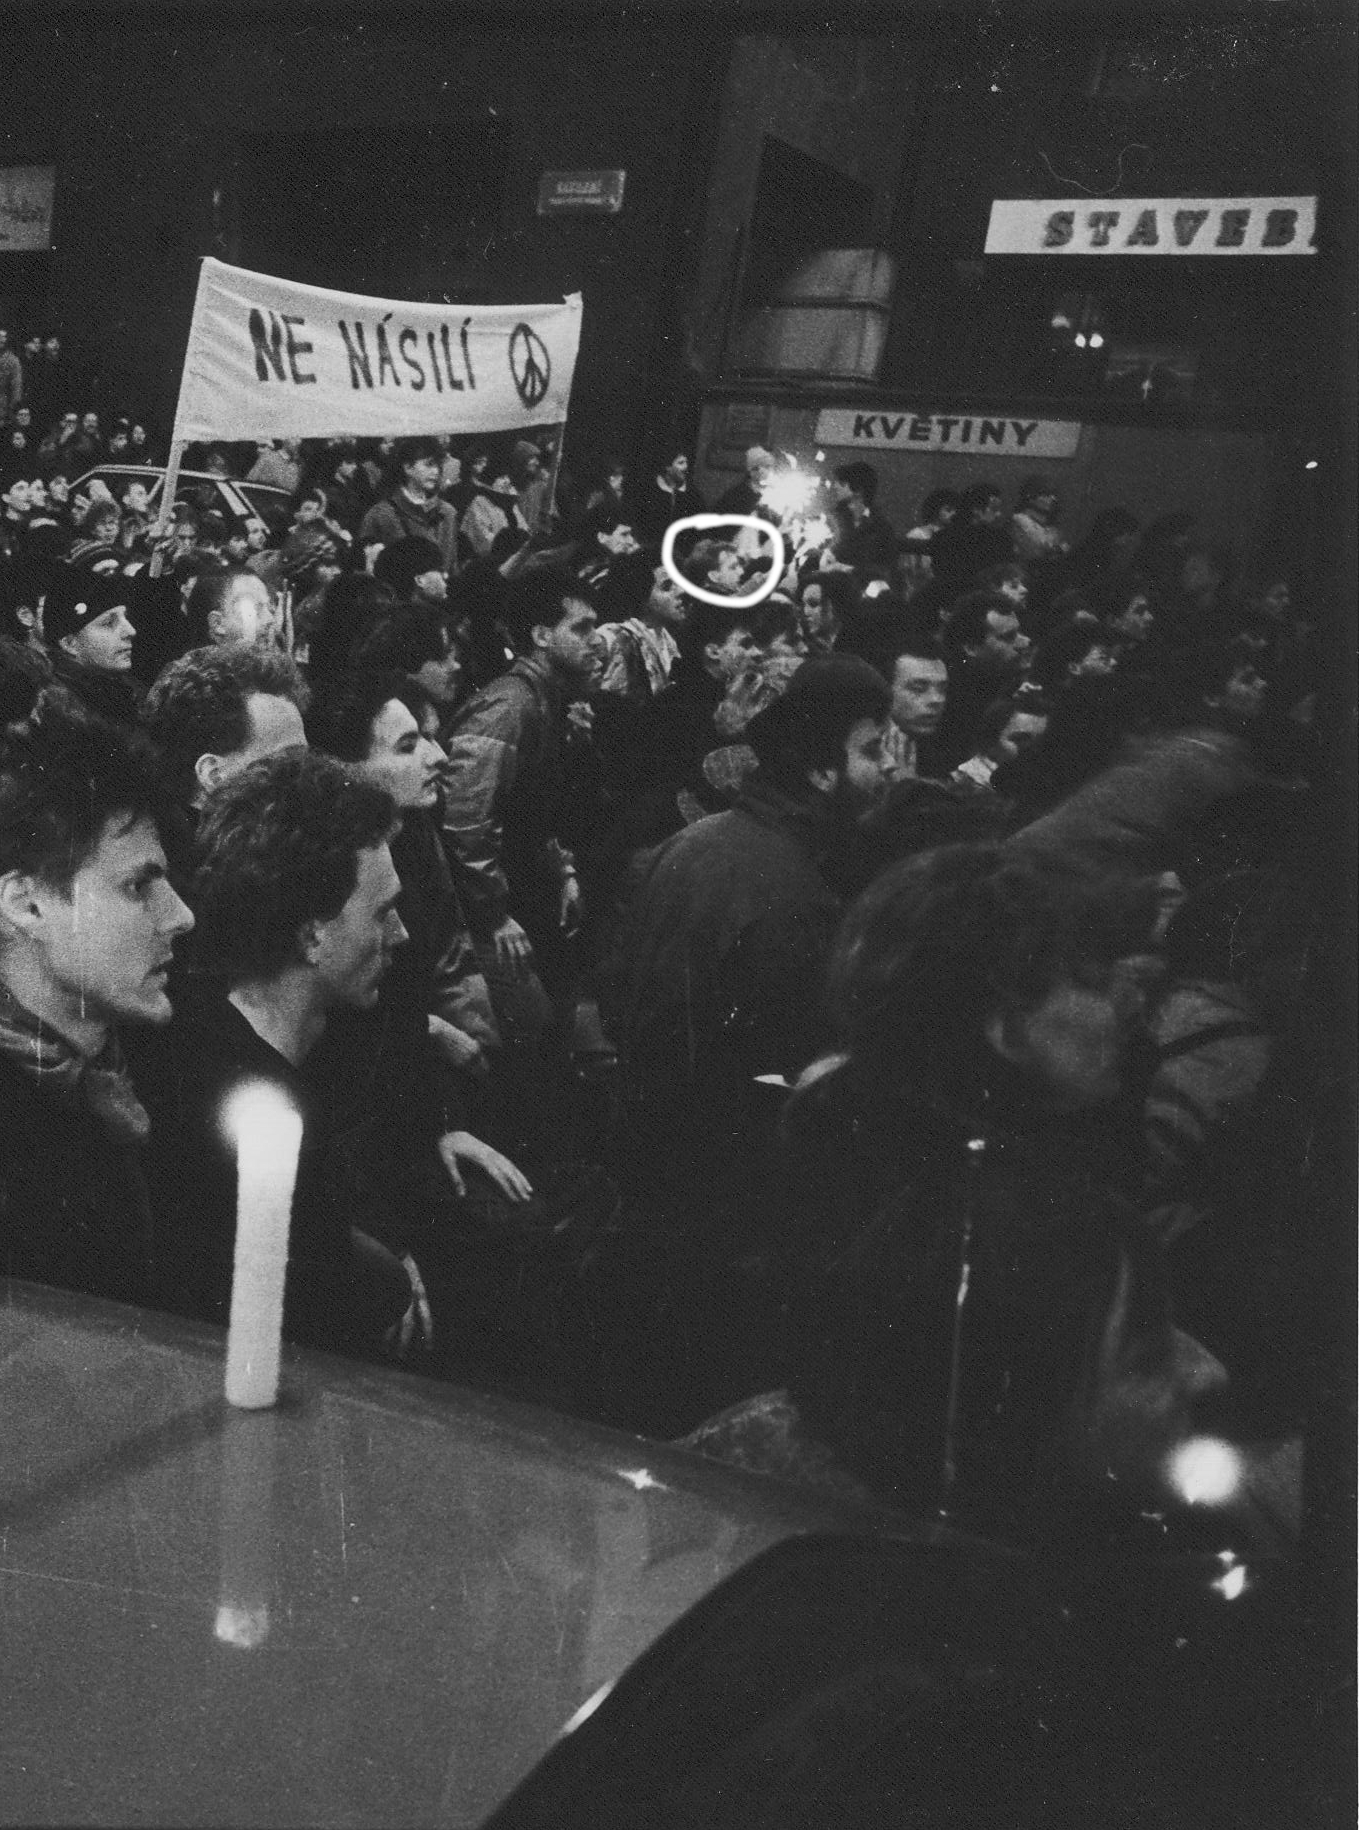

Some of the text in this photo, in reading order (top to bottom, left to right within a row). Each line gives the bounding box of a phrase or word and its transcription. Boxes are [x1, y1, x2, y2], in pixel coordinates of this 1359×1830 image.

[1043, 208, 1316, 247] STAVEB
[249, 308, 476, 393] NE NÁSILÍ
